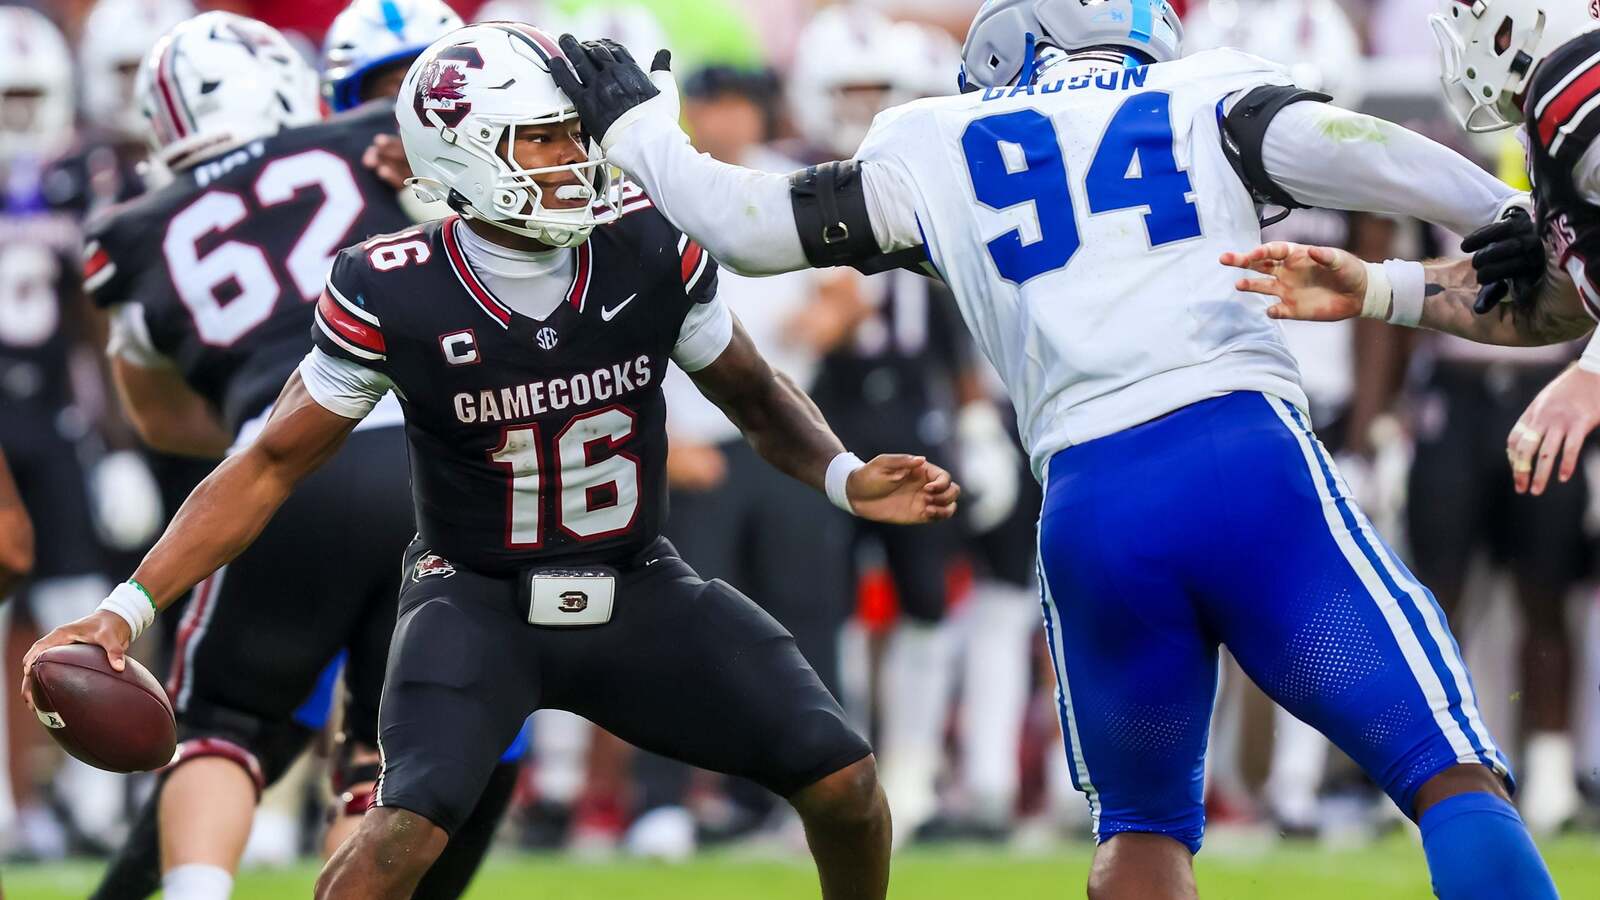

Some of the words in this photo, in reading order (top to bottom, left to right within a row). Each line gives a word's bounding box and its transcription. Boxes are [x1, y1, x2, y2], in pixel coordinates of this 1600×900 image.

[961, 90, 1205, 287] 94
[163, 149, 366, 347] 62
[441, 331, 477, 365] C
[453, 354, 651, 423] GAMECOCKS
[536, 327, 559, 350] SEC
[486, 403, 642, 549] 16
